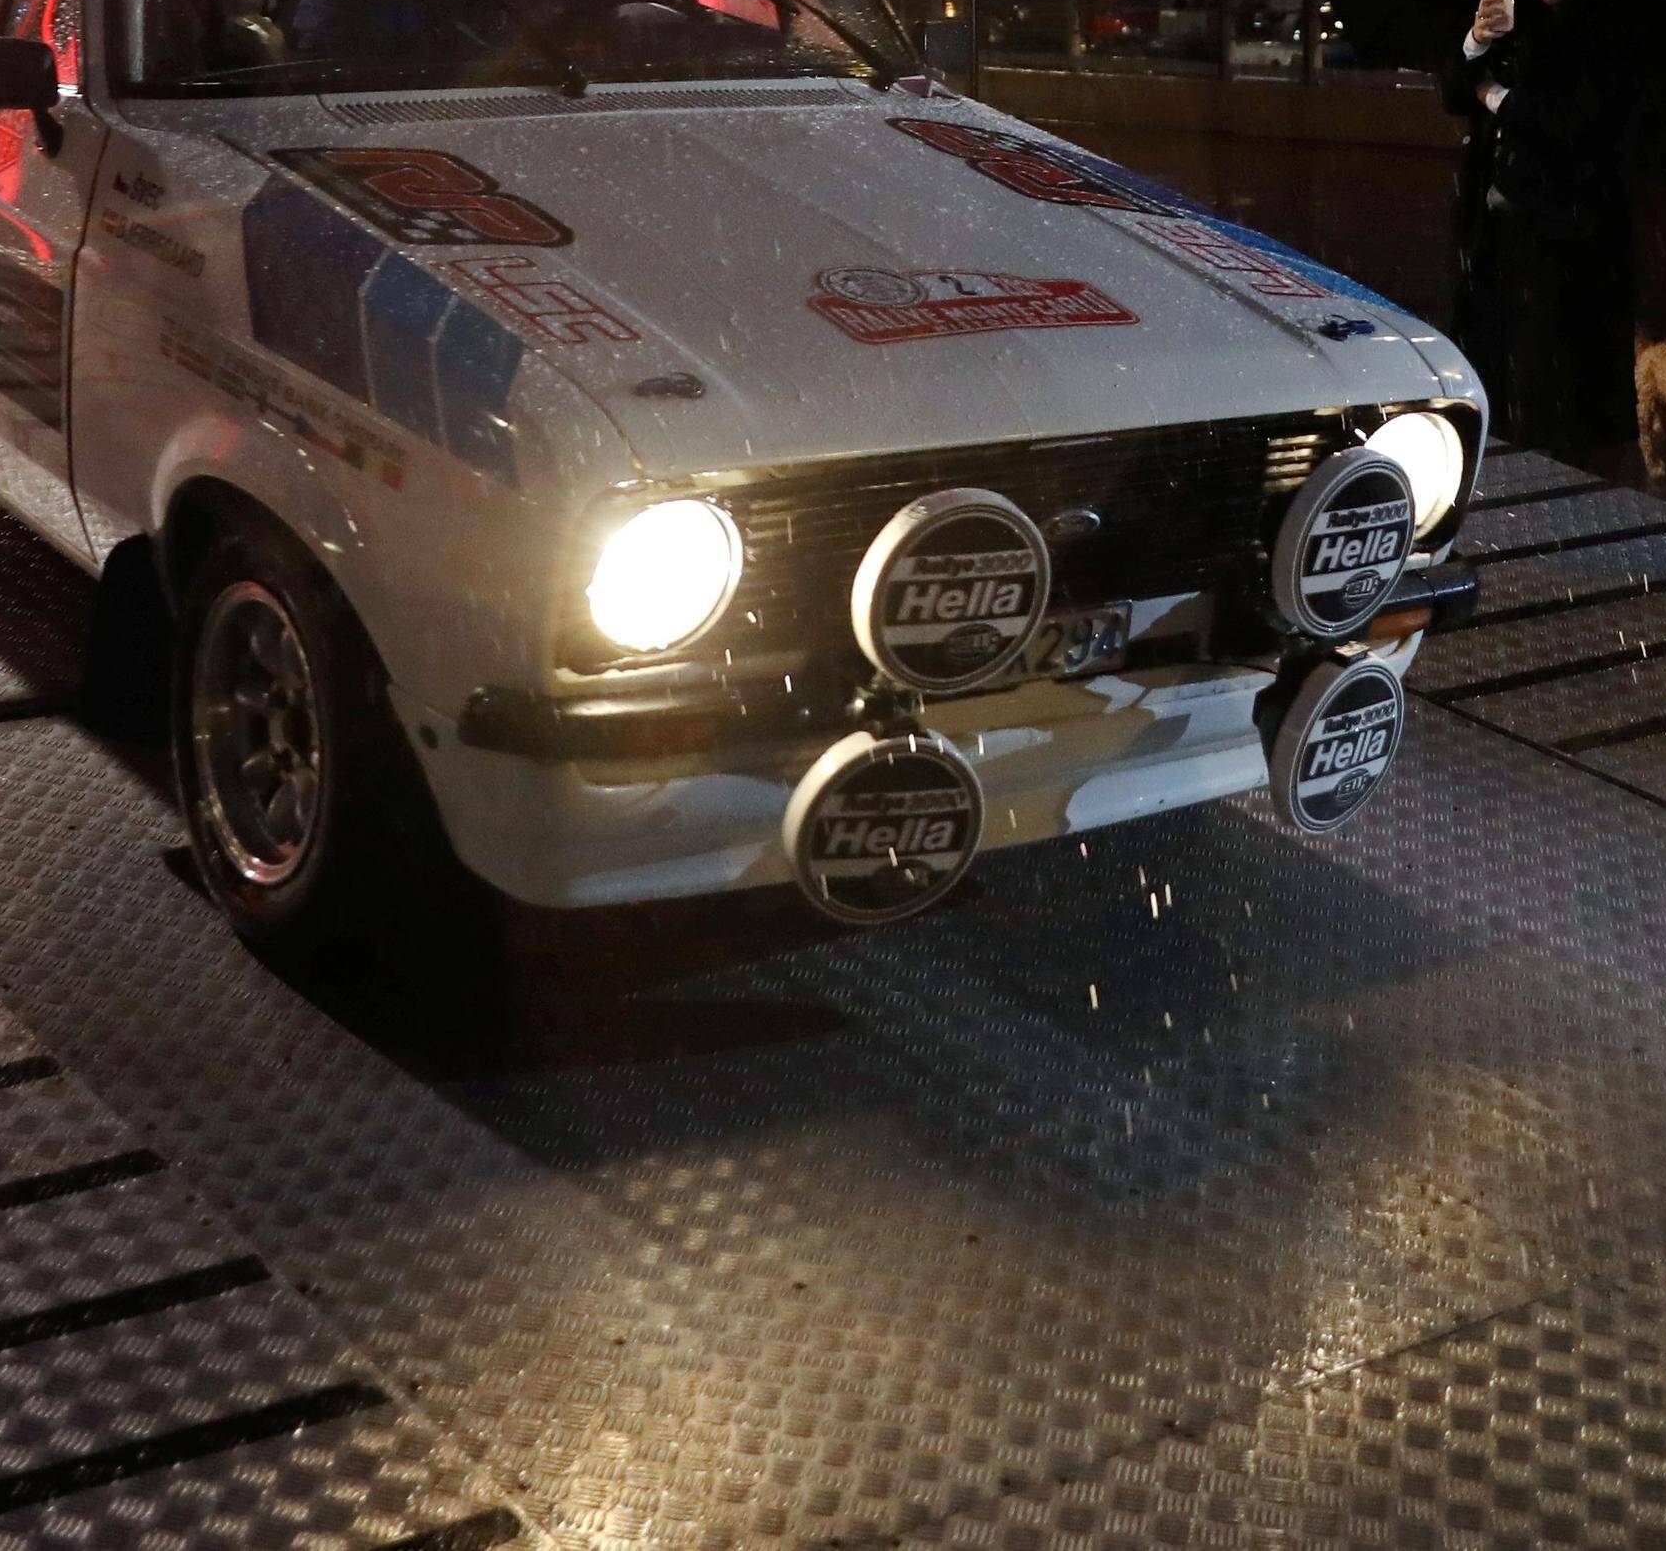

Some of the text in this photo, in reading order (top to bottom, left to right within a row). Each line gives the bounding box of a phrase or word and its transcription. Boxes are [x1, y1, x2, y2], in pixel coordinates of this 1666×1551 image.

[937, 275, 978, 296] 2
[1312, 530, 1399, 572] Hella
[896, 580, 1023, 621] Hella
[1309, 728, 1388, 777] Hella
[824, 816, 955, 855] Hella
